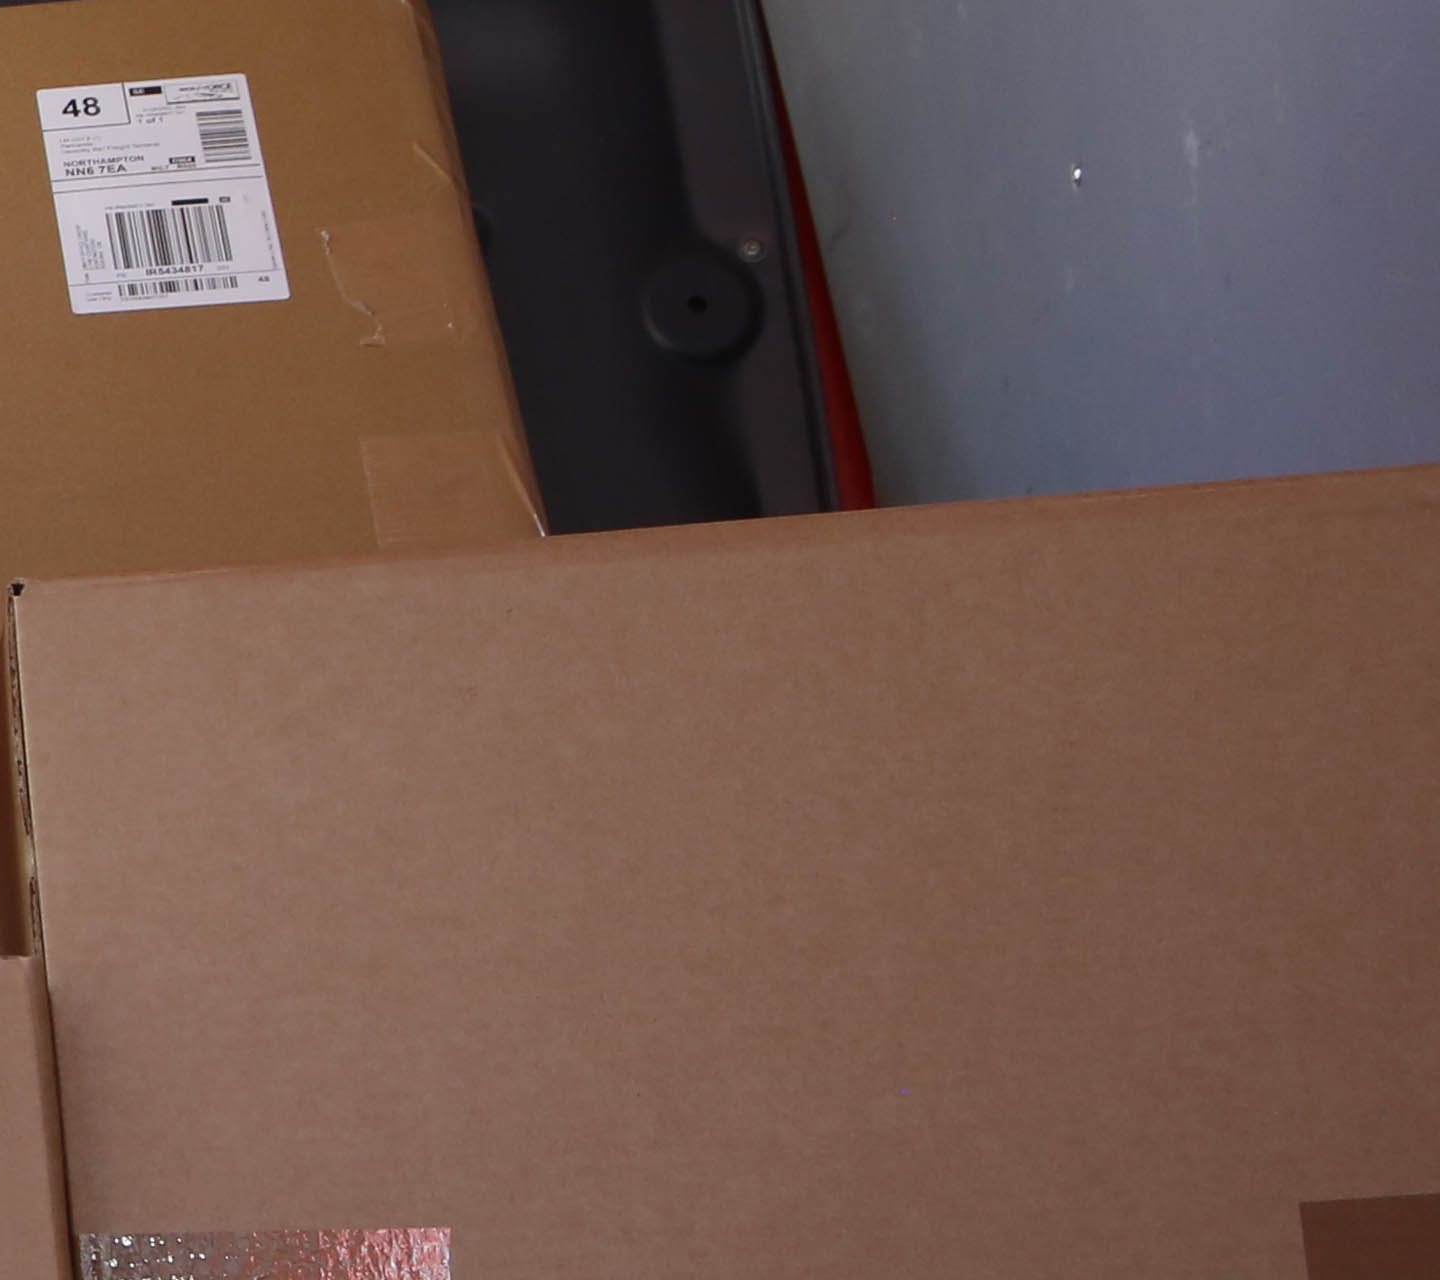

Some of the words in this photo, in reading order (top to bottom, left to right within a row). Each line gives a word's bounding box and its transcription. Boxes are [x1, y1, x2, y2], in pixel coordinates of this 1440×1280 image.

[61, 97, 101, 117] 48
[63, 155, 145, 167] NORTHAMPTON
[65, 165, 95, 176] NN6
[98, 164, 128, 174] 7EA
